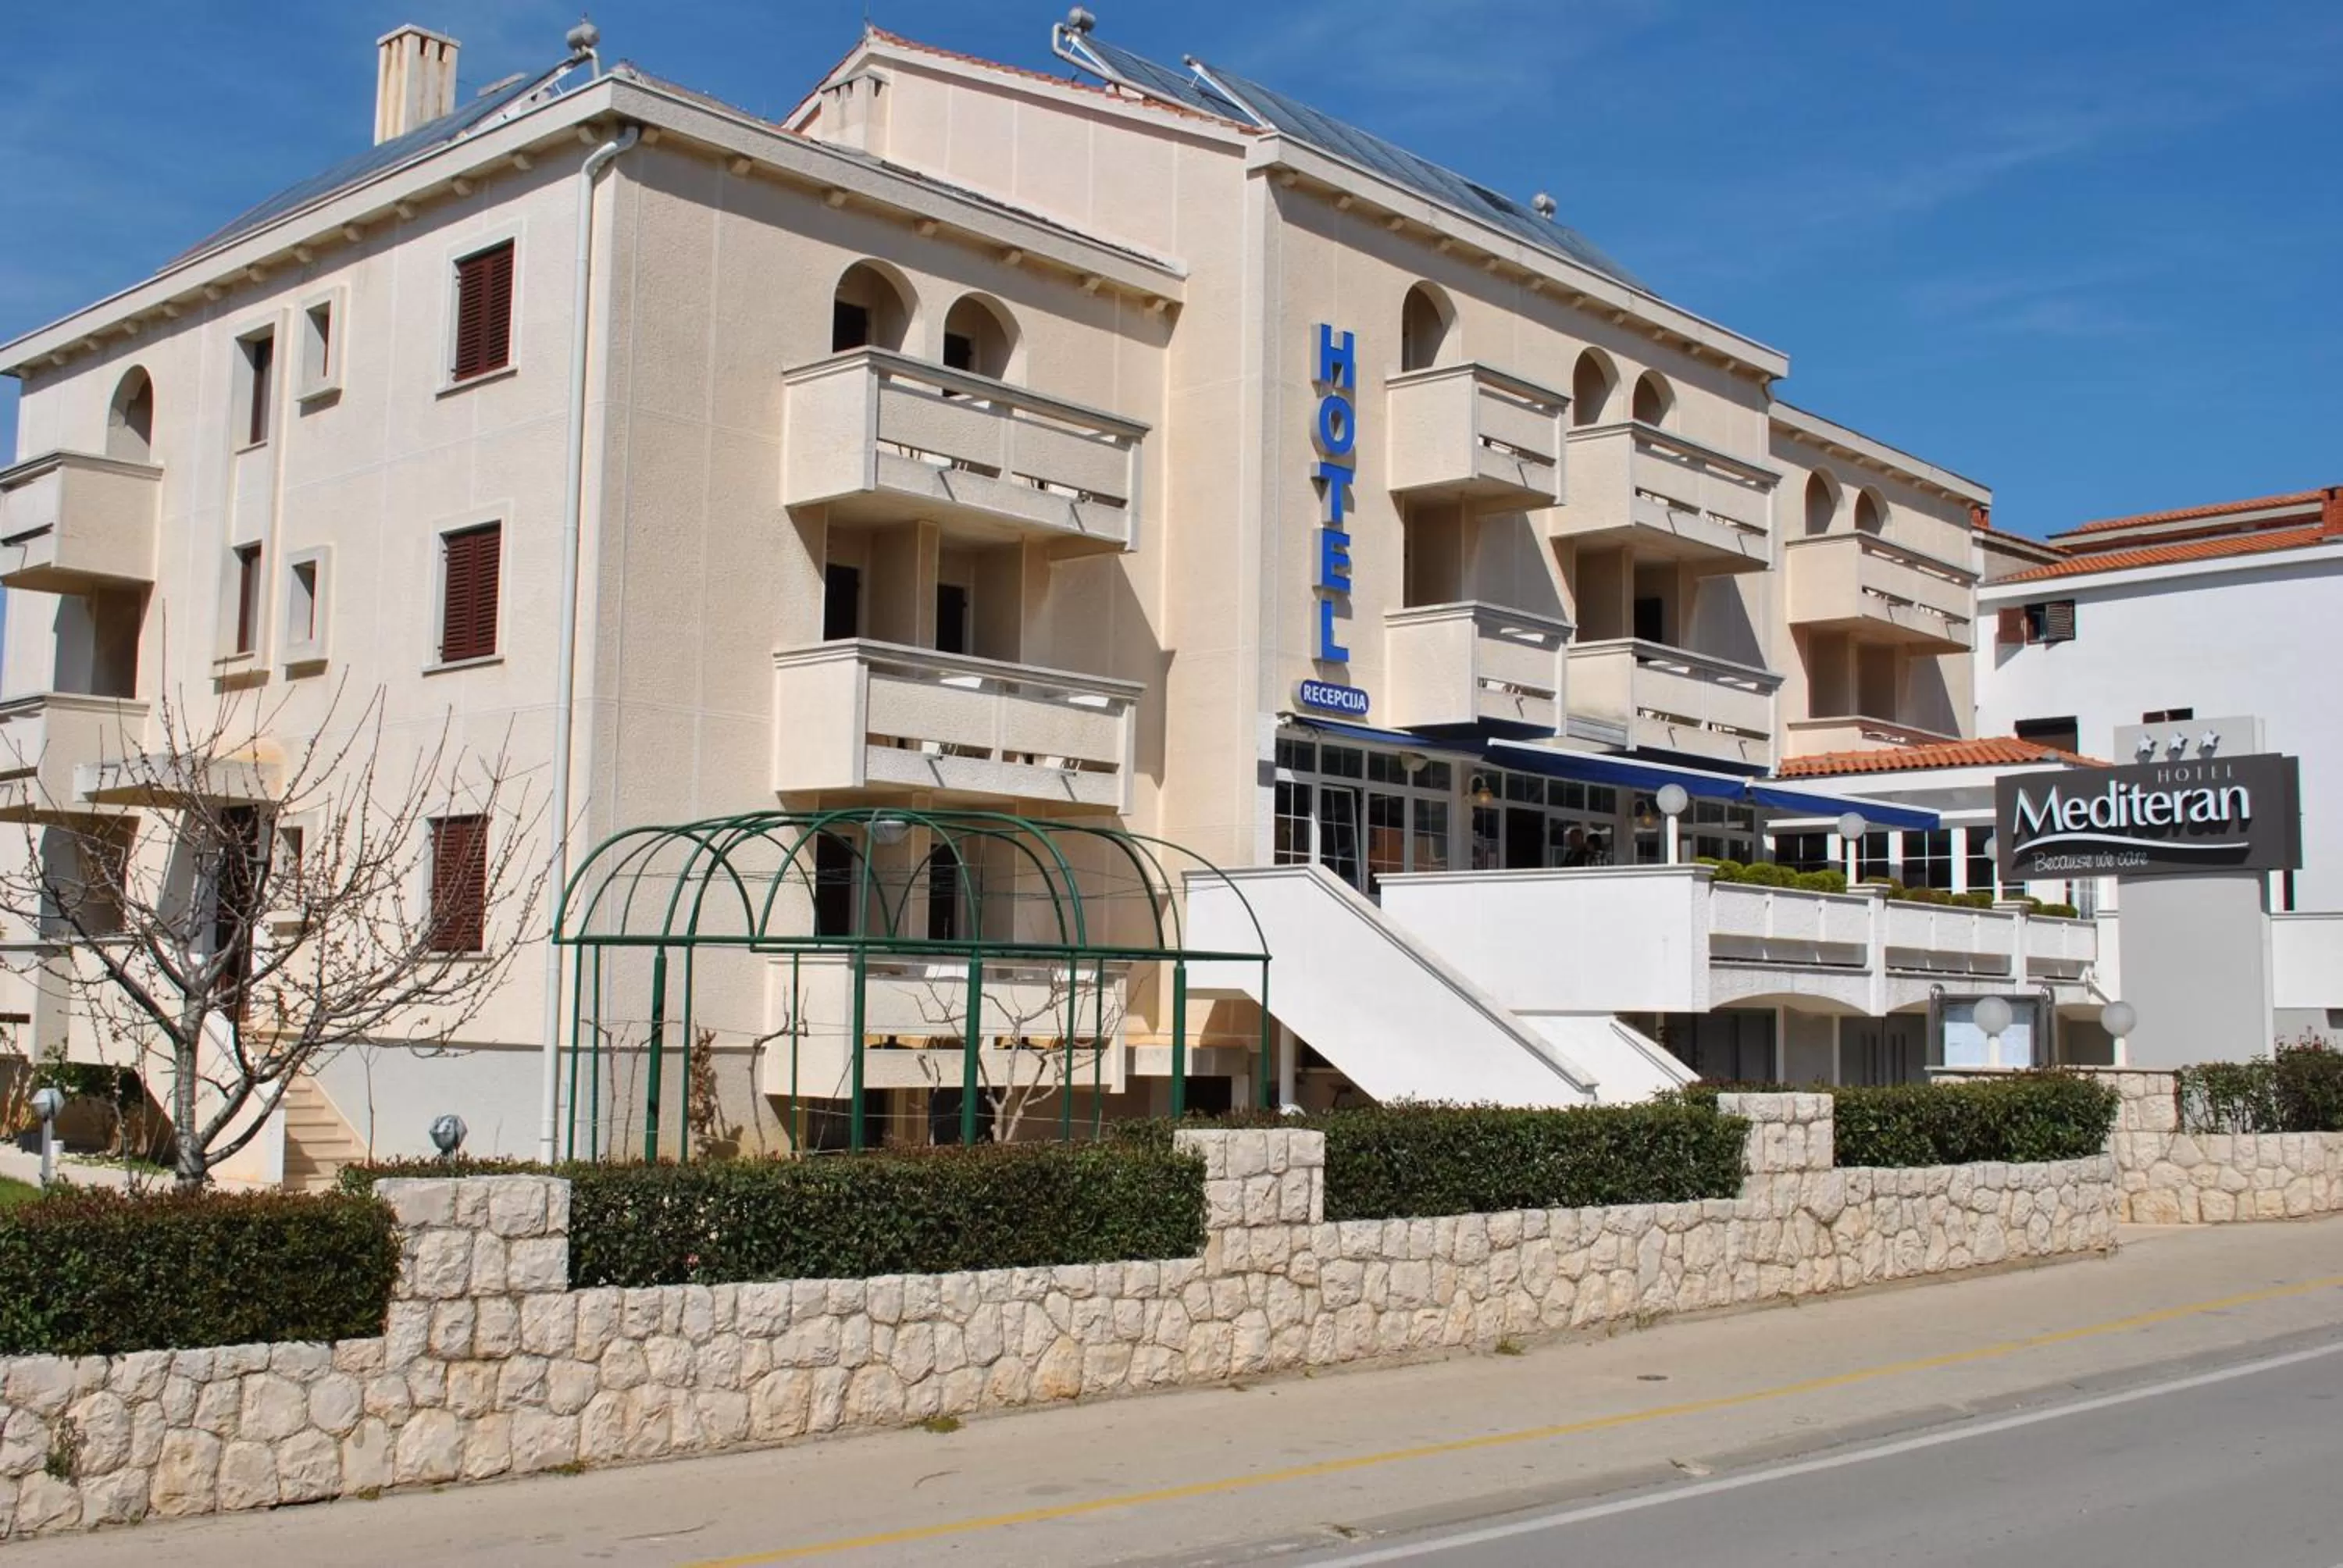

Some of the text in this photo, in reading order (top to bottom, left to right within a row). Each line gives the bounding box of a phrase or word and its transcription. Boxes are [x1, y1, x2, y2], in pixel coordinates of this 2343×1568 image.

[1314, 323, 1356, 664] HOTEL
[1303, 684, 1366, 711] RECEPCIJA
[2013, 780, 2251, 835] Mediteran
[2032, 850, 2149, 872] Because we care
